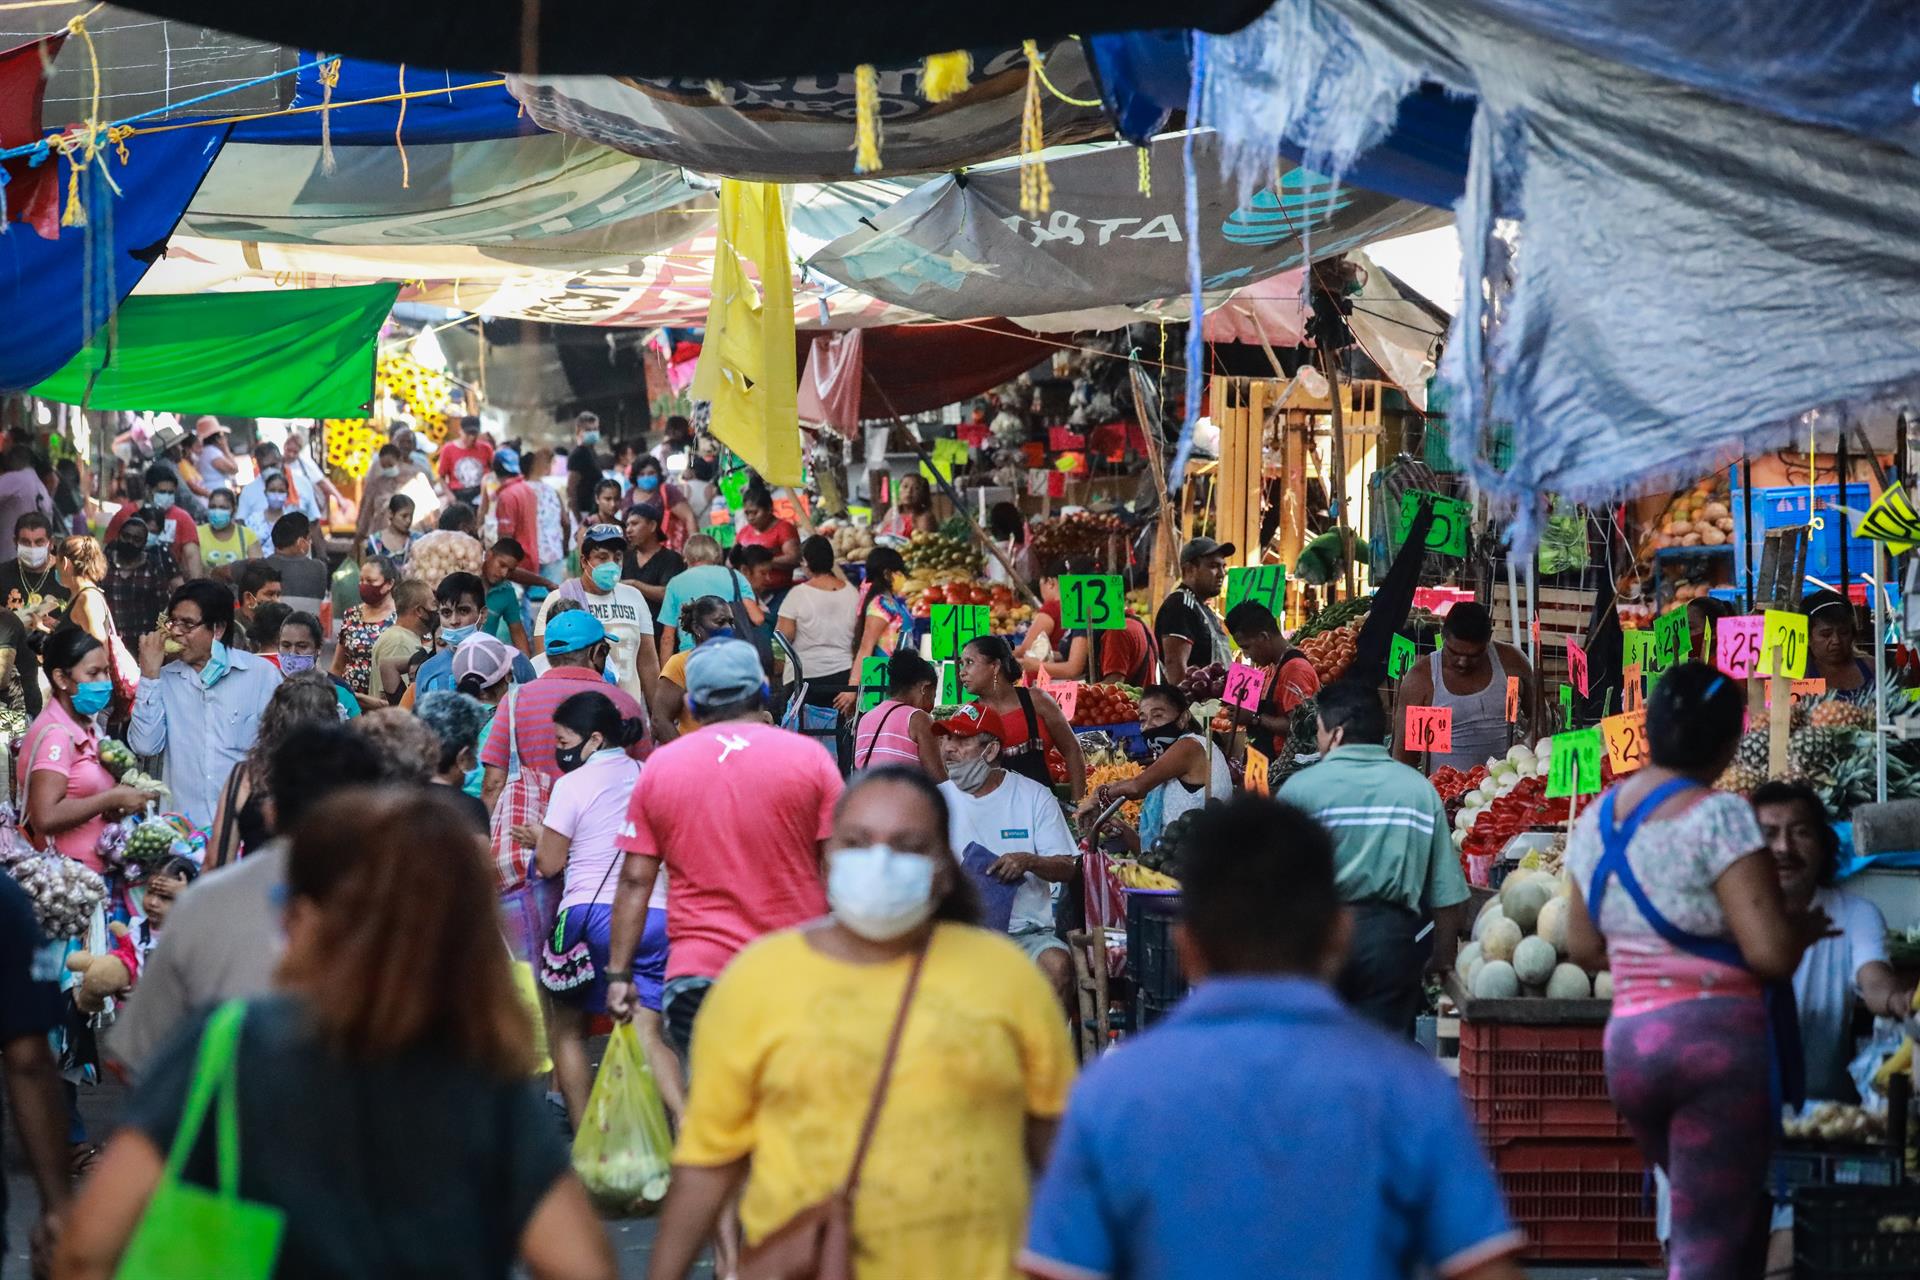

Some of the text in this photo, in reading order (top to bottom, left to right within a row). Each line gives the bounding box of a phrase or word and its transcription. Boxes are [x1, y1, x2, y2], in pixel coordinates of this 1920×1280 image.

[1071, 578, 1110, 624] 13
[611, 604, 636, 621] RUSH
[48, 745, 61, 761] 3
